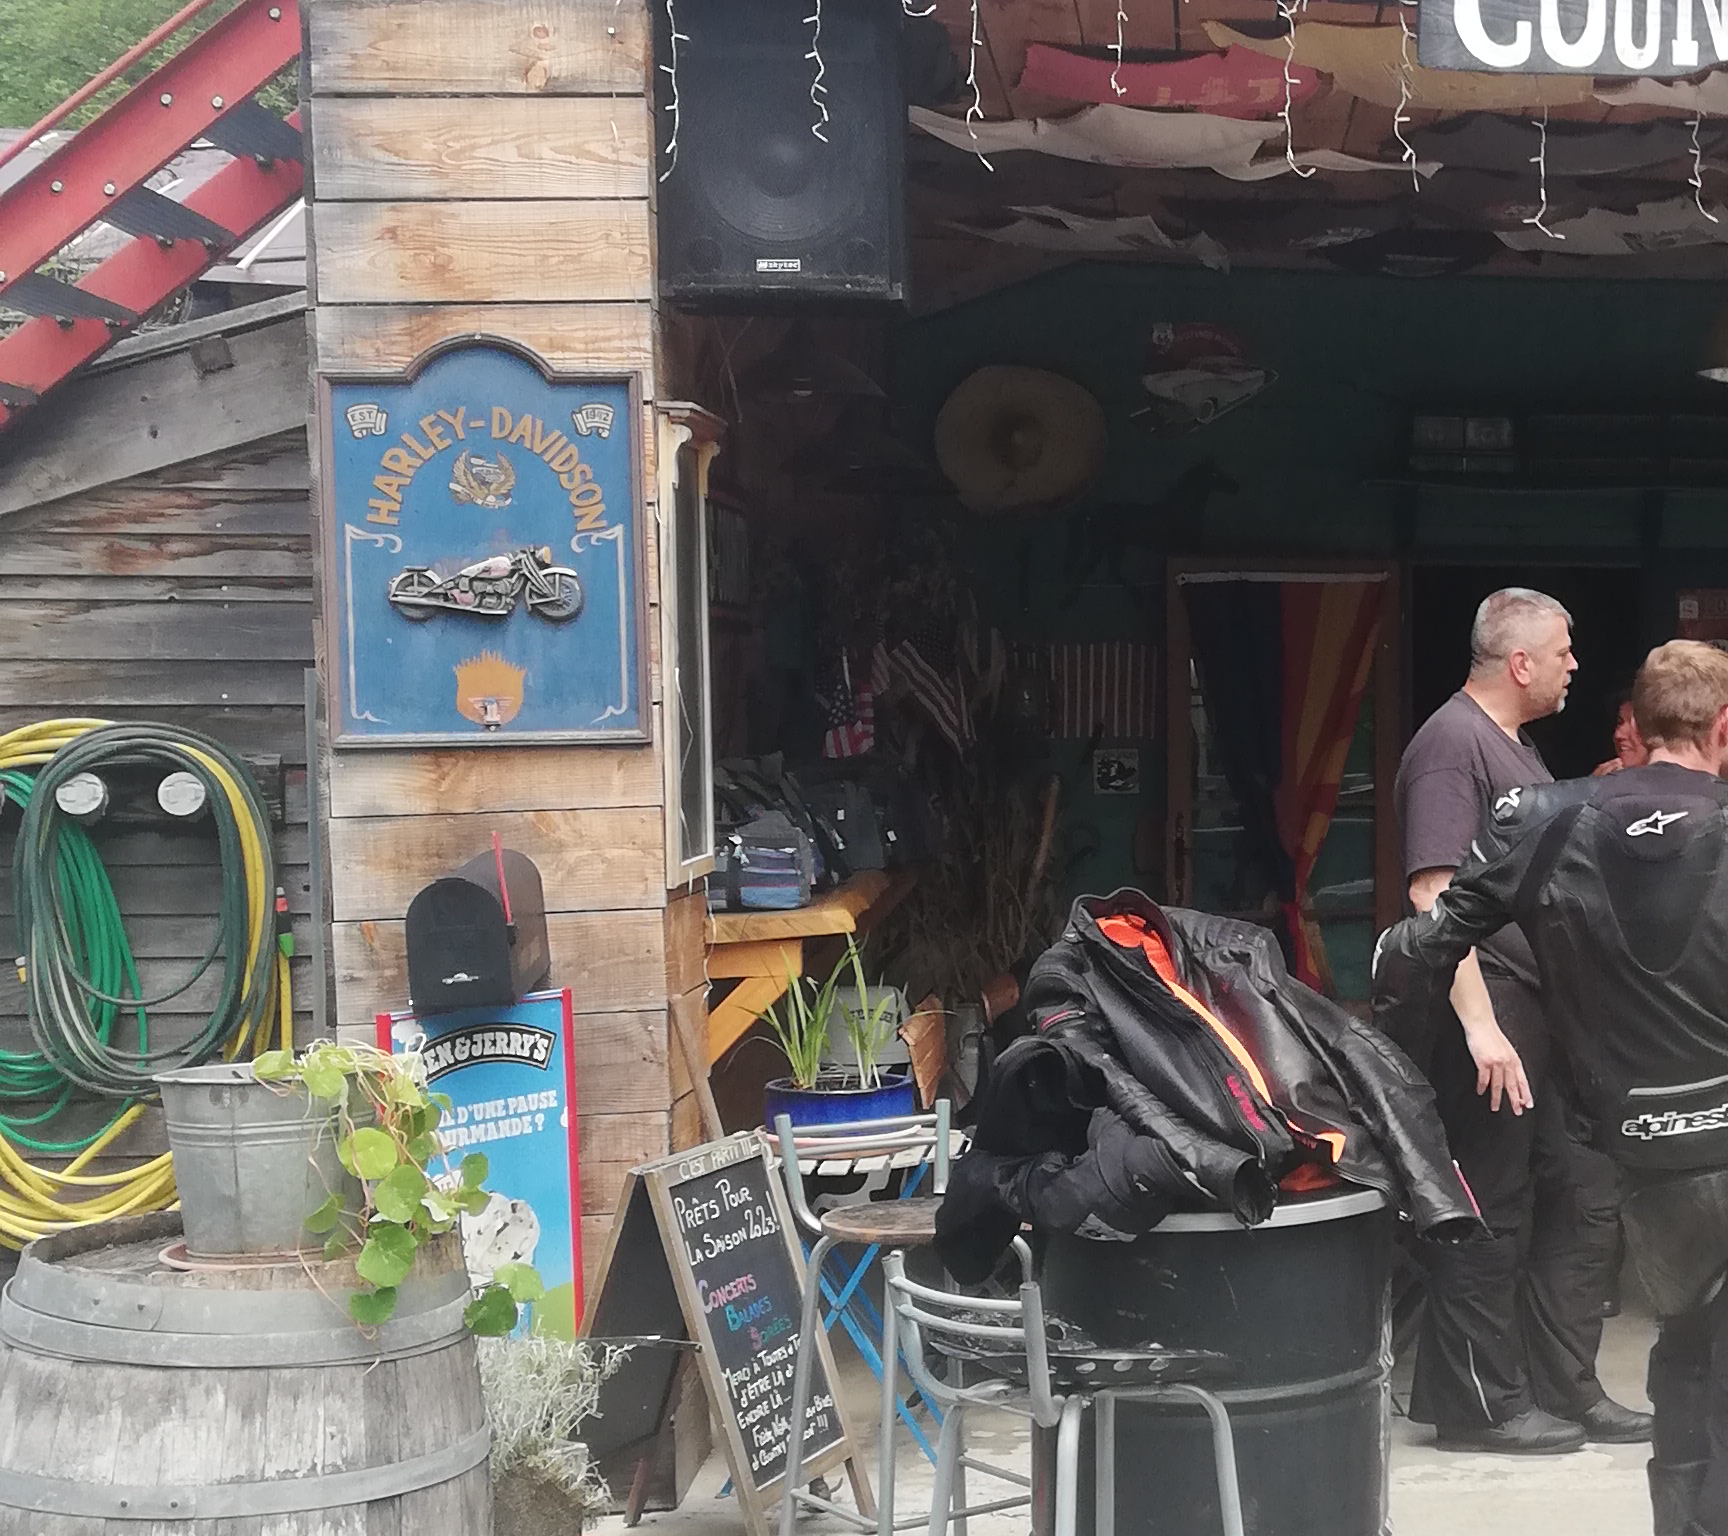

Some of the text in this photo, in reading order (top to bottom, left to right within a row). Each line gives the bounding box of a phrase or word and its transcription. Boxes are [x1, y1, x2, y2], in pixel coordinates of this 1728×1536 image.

[350, 410, 374, 423] EST
[366, 406, 608, 533] HARLEY-DAVIDSON
[457, 1098, 507, 1125] D'UNE
[508, 1089, 558, 1114] PAUSE
[438, 1115, 533, 1148] OURMANDE
[685, 1240, 704, 1266] LA
